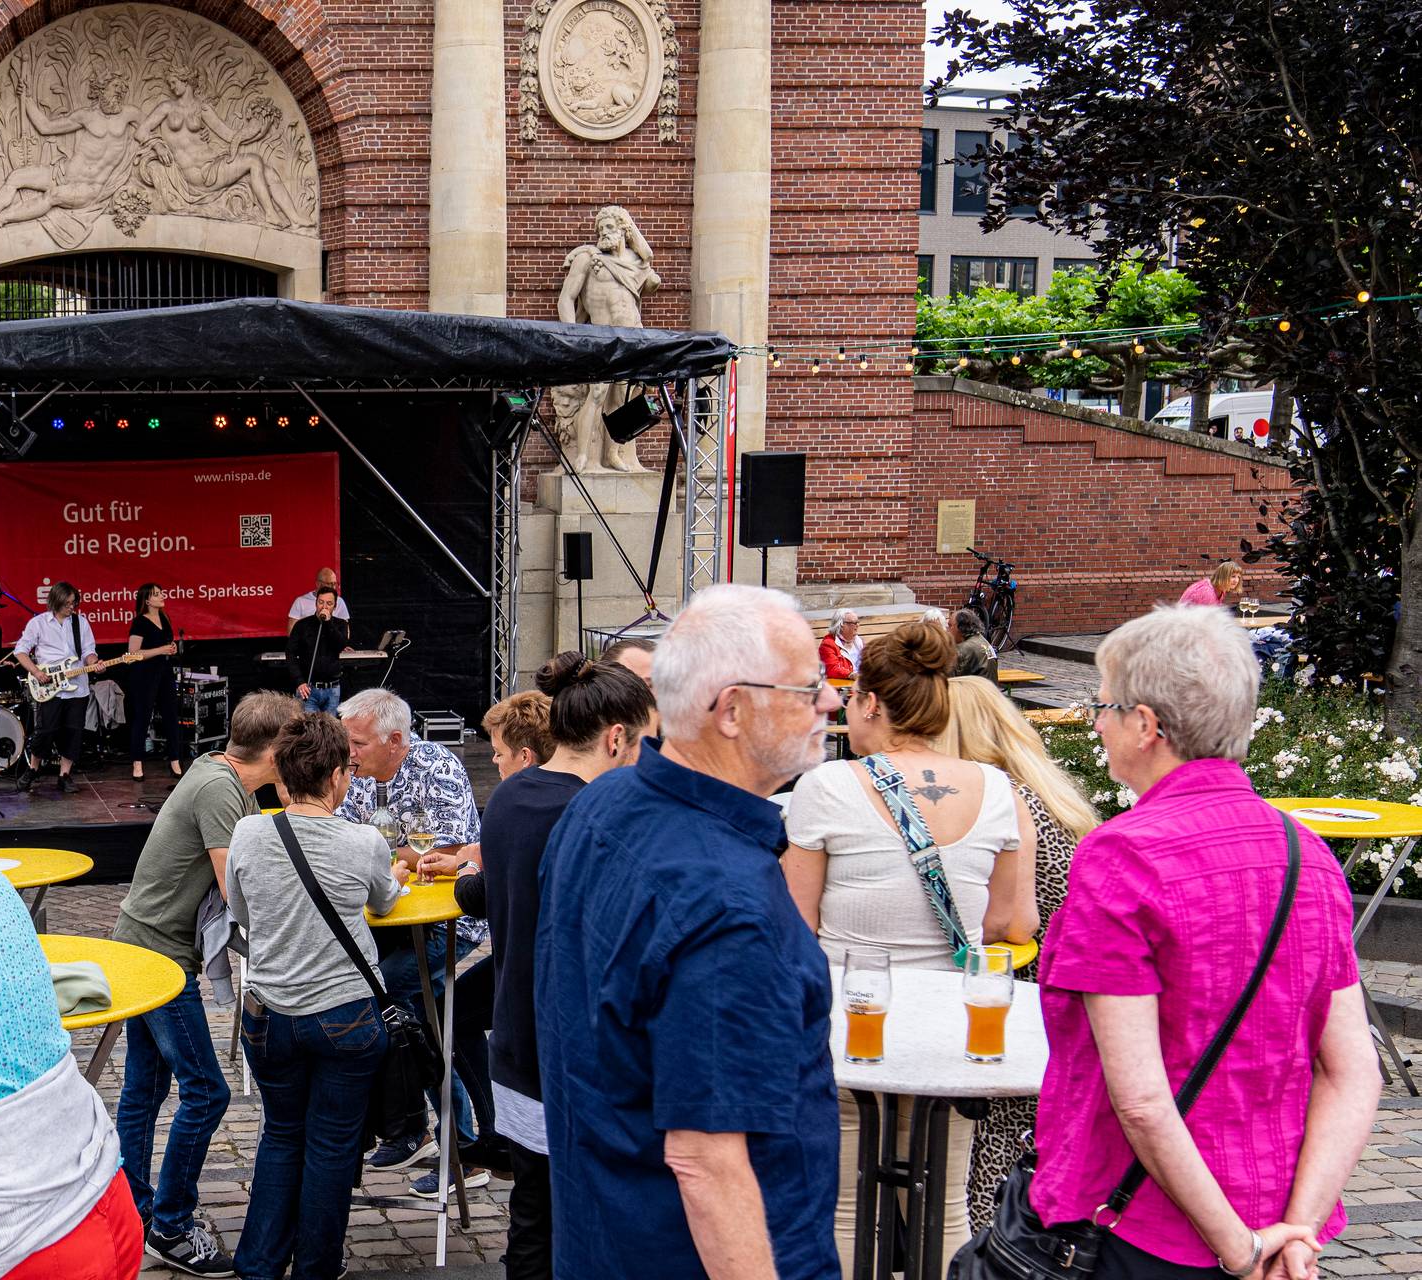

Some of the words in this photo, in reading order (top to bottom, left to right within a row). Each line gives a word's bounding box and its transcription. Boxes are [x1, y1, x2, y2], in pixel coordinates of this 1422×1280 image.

[193, 470, 272, 484] www.nispa.de
[63, 503, 105, 523] Gut
[109, 500, 143, 521] für
[64, 534, 100, 555] die
[107, 531, 195, 558] Region.
[78, 584, 194, 603] iederrhesche
[198, 583, 274, 601] Sparkasse
[78, 607, 137, 625] heinLip
